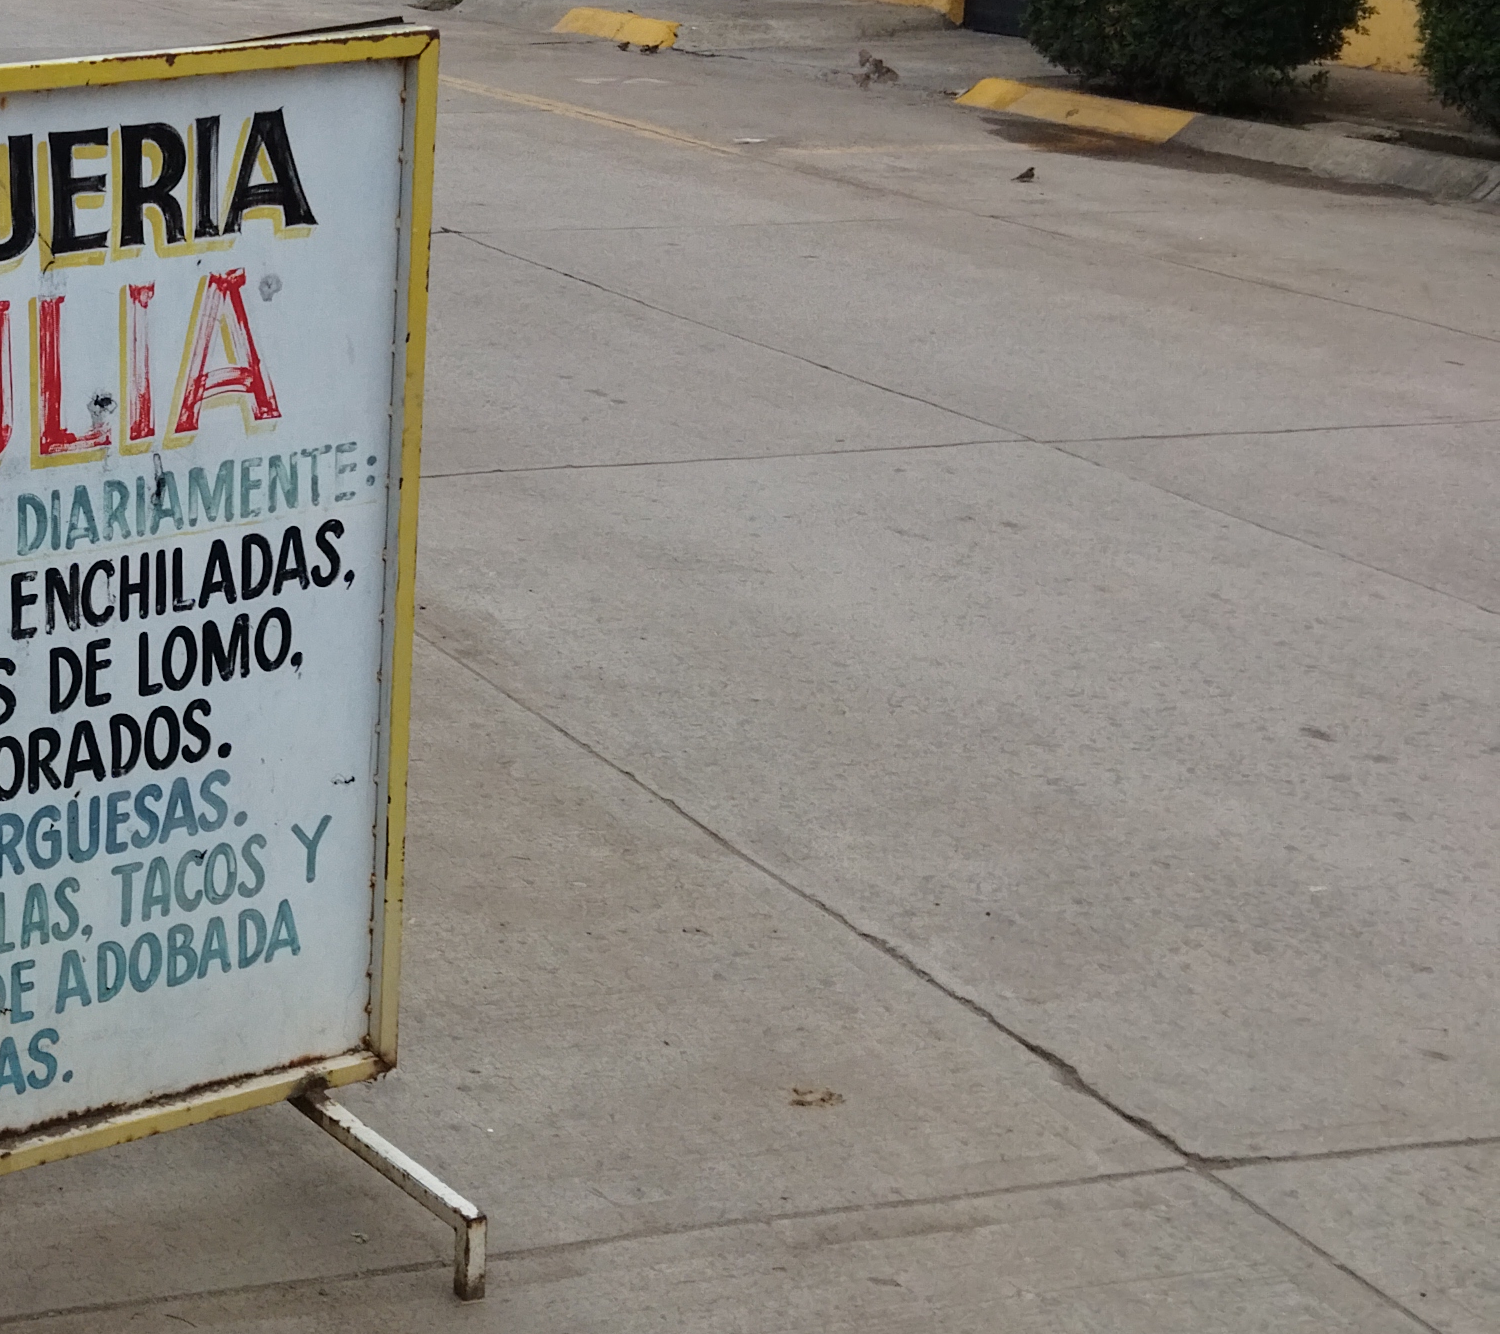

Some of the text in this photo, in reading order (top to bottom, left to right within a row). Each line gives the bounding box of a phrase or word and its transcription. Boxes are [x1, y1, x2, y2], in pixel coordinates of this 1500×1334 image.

[11, 519, 356, 640] ENCHILADAS,
[50, 638, 112, 715] DE
[111, 834, 267, 928] TACOS
[291, 814, 333, 883] Y
[55, 899, 301, 1014] ADOBADA
